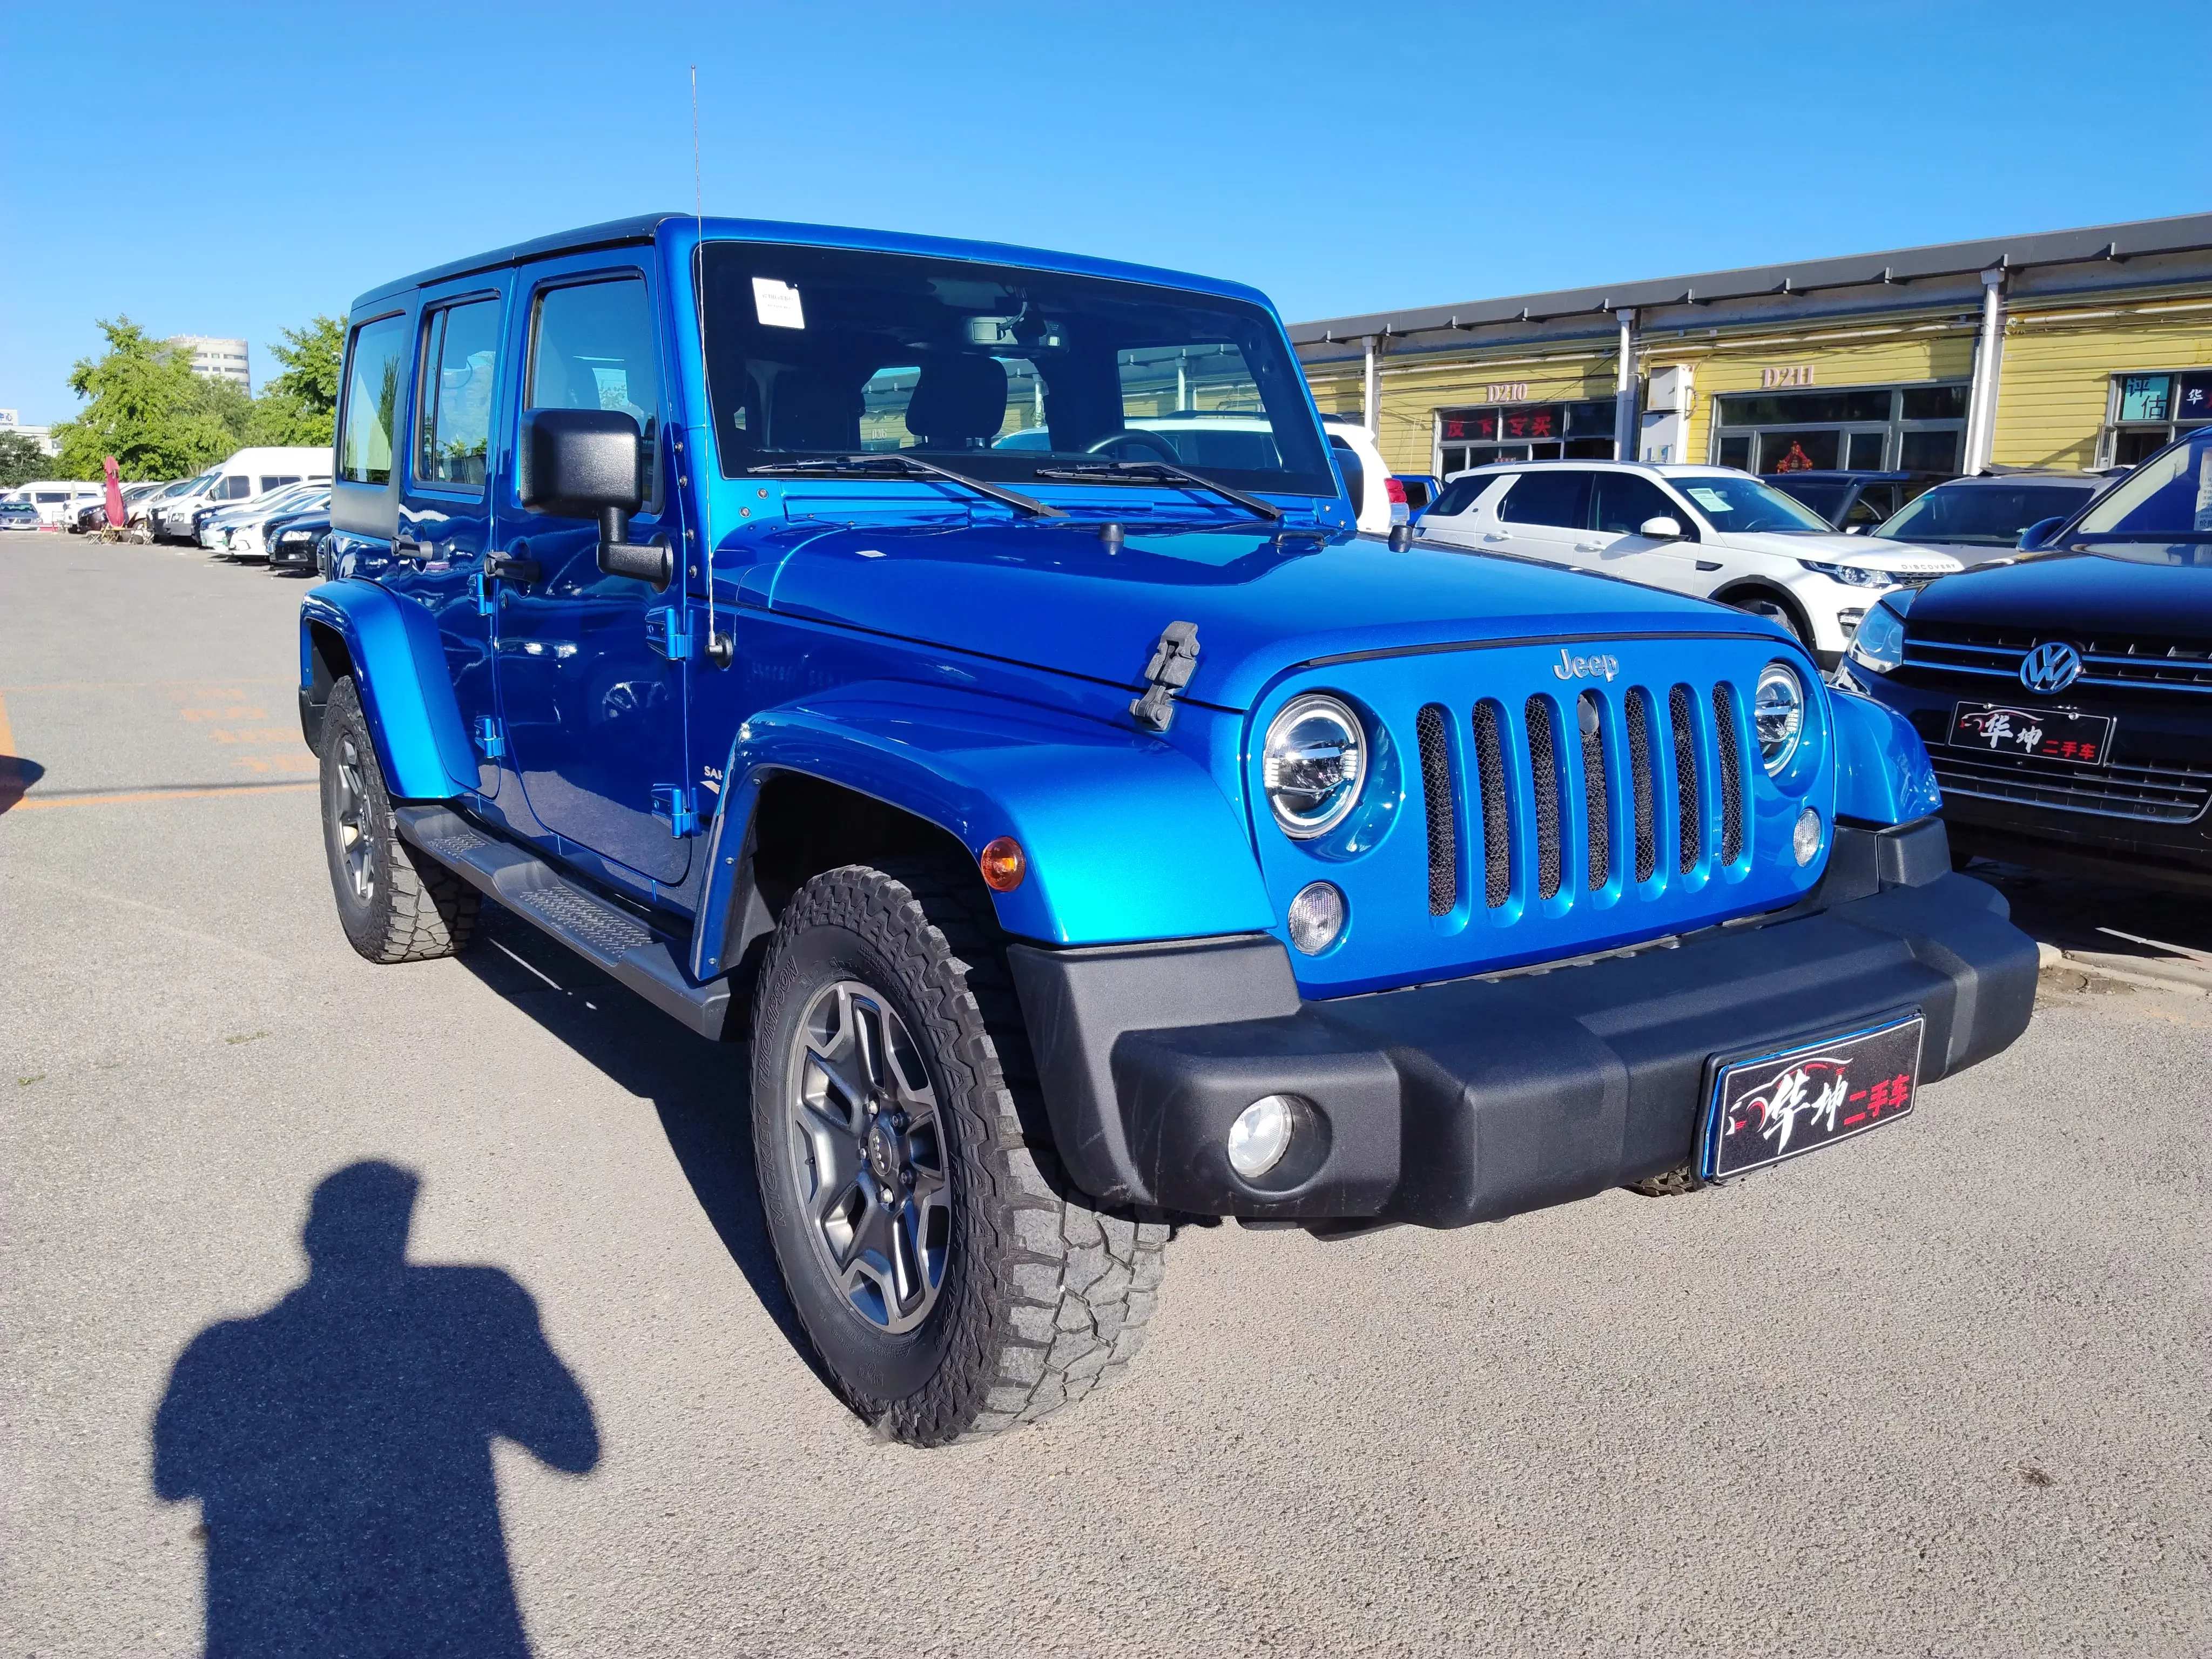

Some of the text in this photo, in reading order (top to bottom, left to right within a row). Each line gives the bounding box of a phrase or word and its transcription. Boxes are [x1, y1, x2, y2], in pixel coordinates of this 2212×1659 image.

[1486, 383, 1527, 402] D210
[1761, 365, 1814, 388] D211
[2128, 378, 2167, 419] 评估
[1553, 649, 1620, 683] Jeep
[1980, 713, 2096, 760] 华坤 二手车
[758, 955, 798, 1089] THOMPSON
[1763, 1068, 1910, 1155] 华坤 二手车
